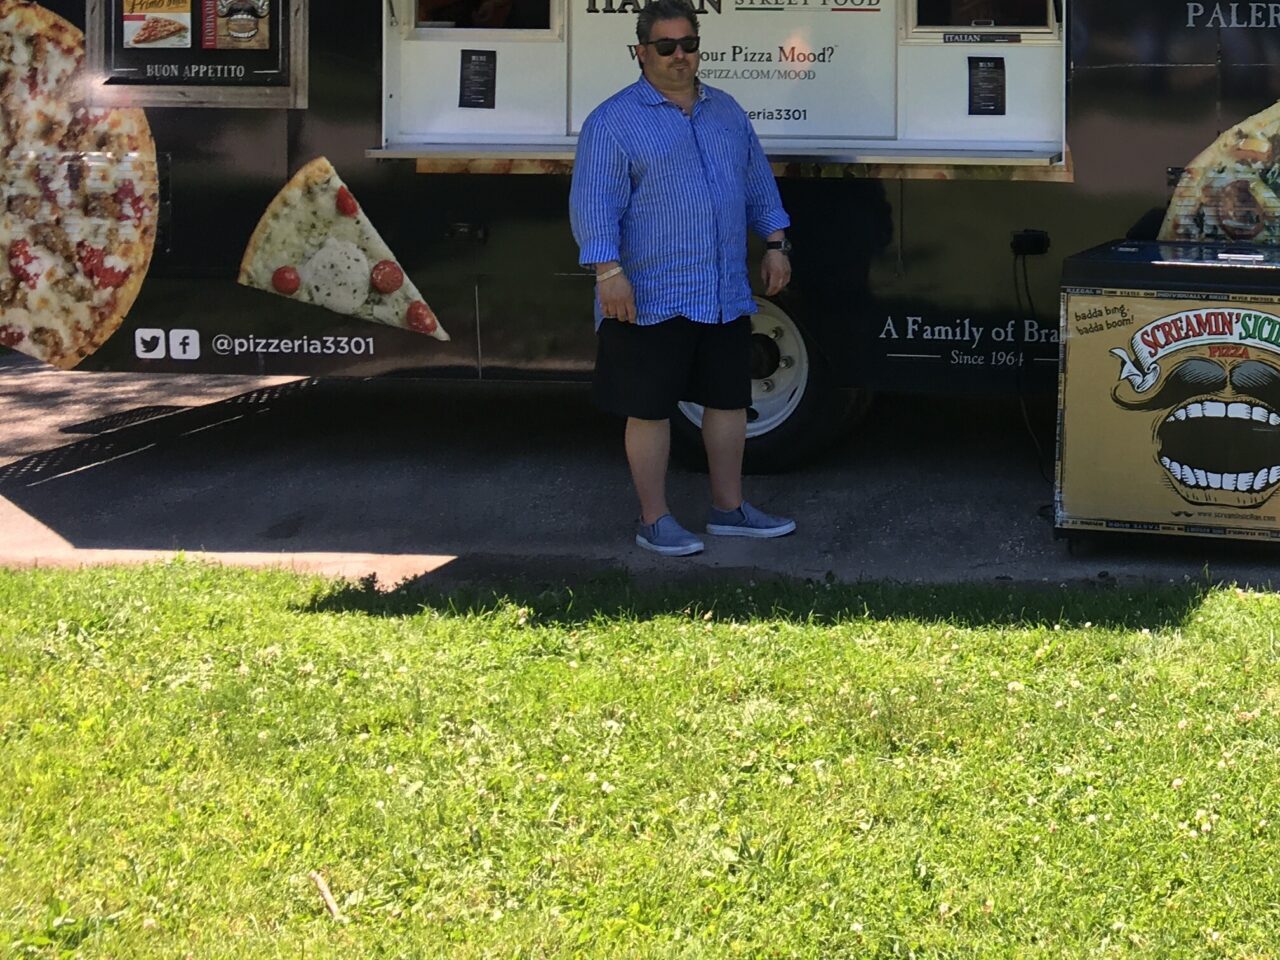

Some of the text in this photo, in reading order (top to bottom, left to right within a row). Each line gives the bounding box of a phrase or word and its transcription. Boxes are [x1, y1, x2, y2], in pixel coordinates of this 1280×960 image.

[945, 34, 981, 42] ITALIAN
[699, 45, 835, 63] our Pizza Mood?
[146, 64, 245, 78] BUON APPETITO
[695, 68, 816, 81] SPIZZA.COM/MOOD
[744, 109, 807, 121] eria3301
[1075, 310, 1103, 322] badda
[879, 316, 1060, 348] A Family of Bra
[1076, 315, 1135, 336] badda boom!
[1140, 312, 1242, 358] SCREAMIN'
[212, 334, 374, 355] @pizzeria3301
[950, 350, 985, 365] Since
[1208, 346, 1250, 359] PIZZA
